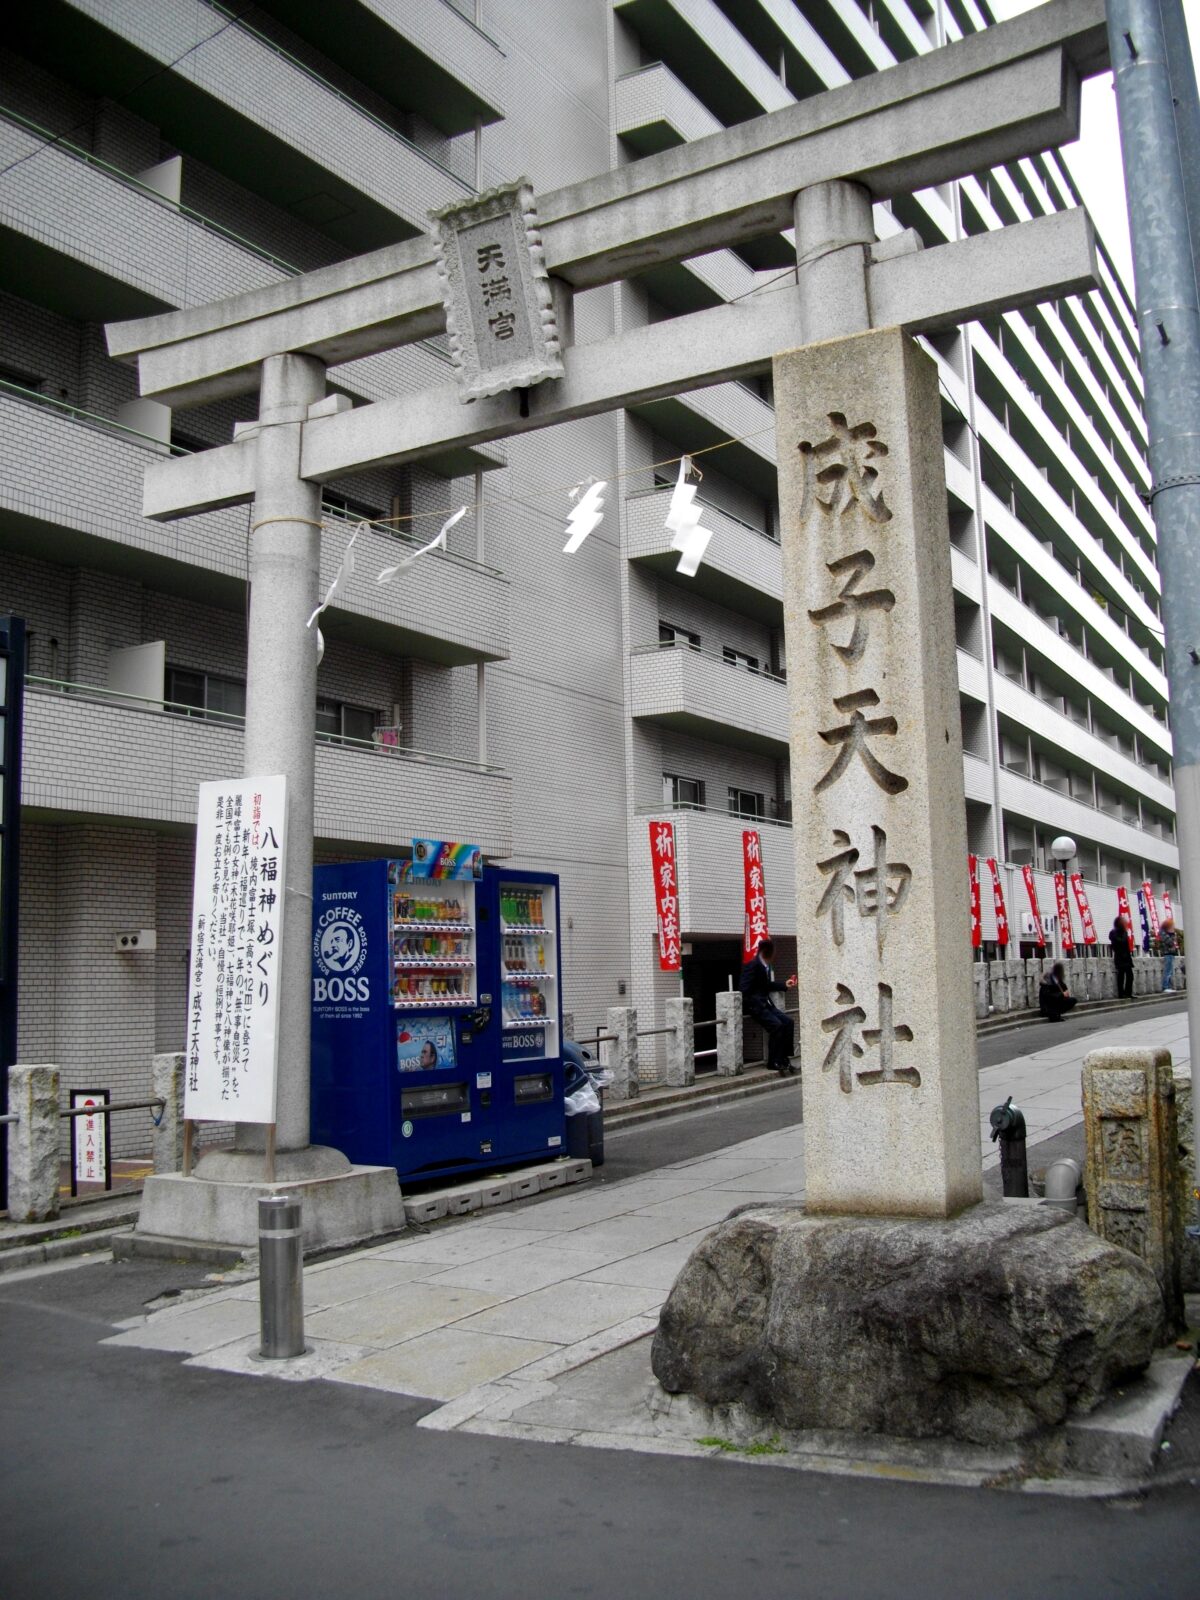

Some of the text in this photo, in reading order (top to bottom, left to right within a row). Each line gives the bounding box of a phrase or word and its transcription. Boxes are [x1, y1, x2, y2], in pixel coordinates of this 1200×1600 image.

[477, 243, 516, 341] 天満宮
[797, 411, 921, 1094] 成子天神社
[256, 827, 279, 1006] 八福神めぐり
[319, 906, 362, 927] COFFEE
[313, 928, 323, 957] COFFEE
[351, 926, 367, 975] BOSS COFFEE
[313, 976, 370, 1002] BOSS
[513, 1034, 535, 1048] BOSS
[399, 1056, 421, 1069] BOSS
[86, 1119, 95, 1178] 進入禁止
